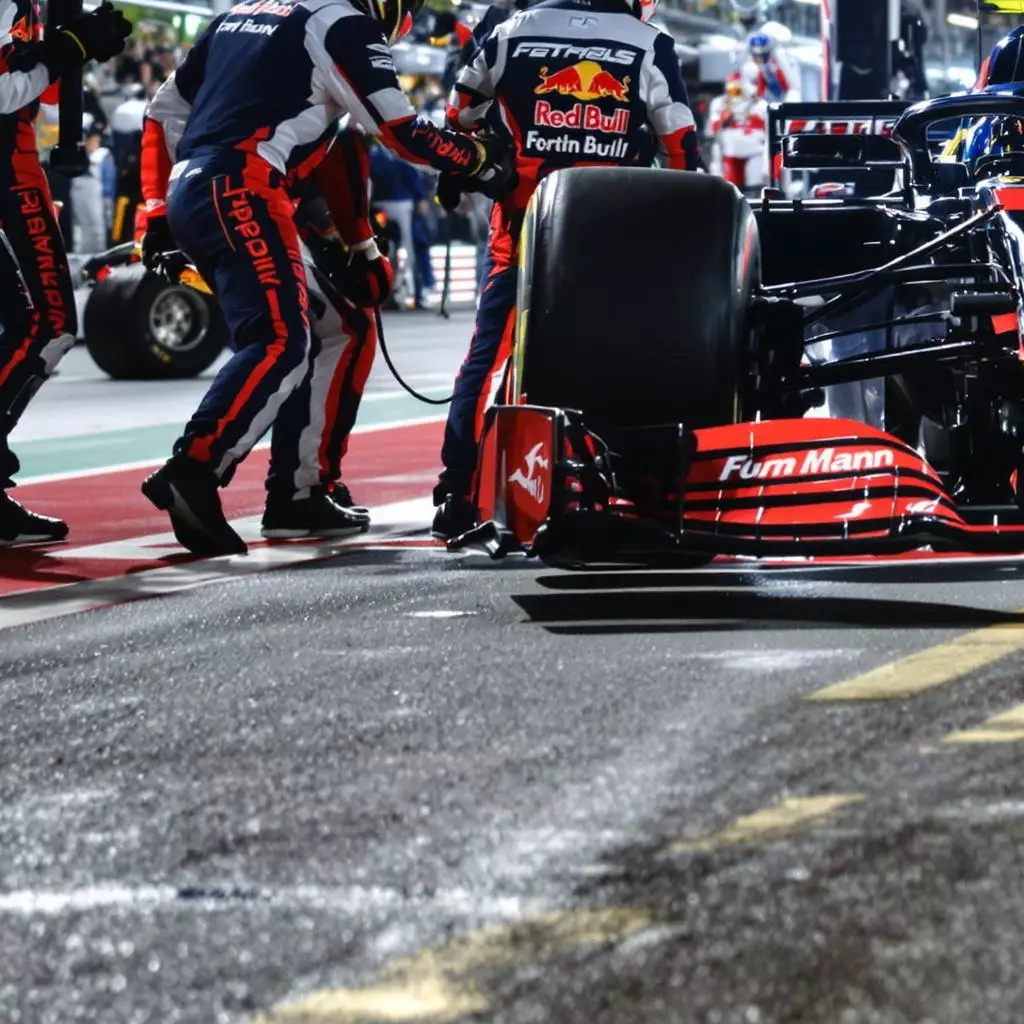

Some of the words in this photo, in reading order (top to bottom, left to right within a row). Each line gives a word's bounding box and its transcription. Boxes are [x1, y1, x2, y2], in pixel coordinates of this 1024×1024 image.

[534, 100, 581, 128] Red
[583, 105, 630, 135] Bull
[799, 447, 894, 475] Mann
